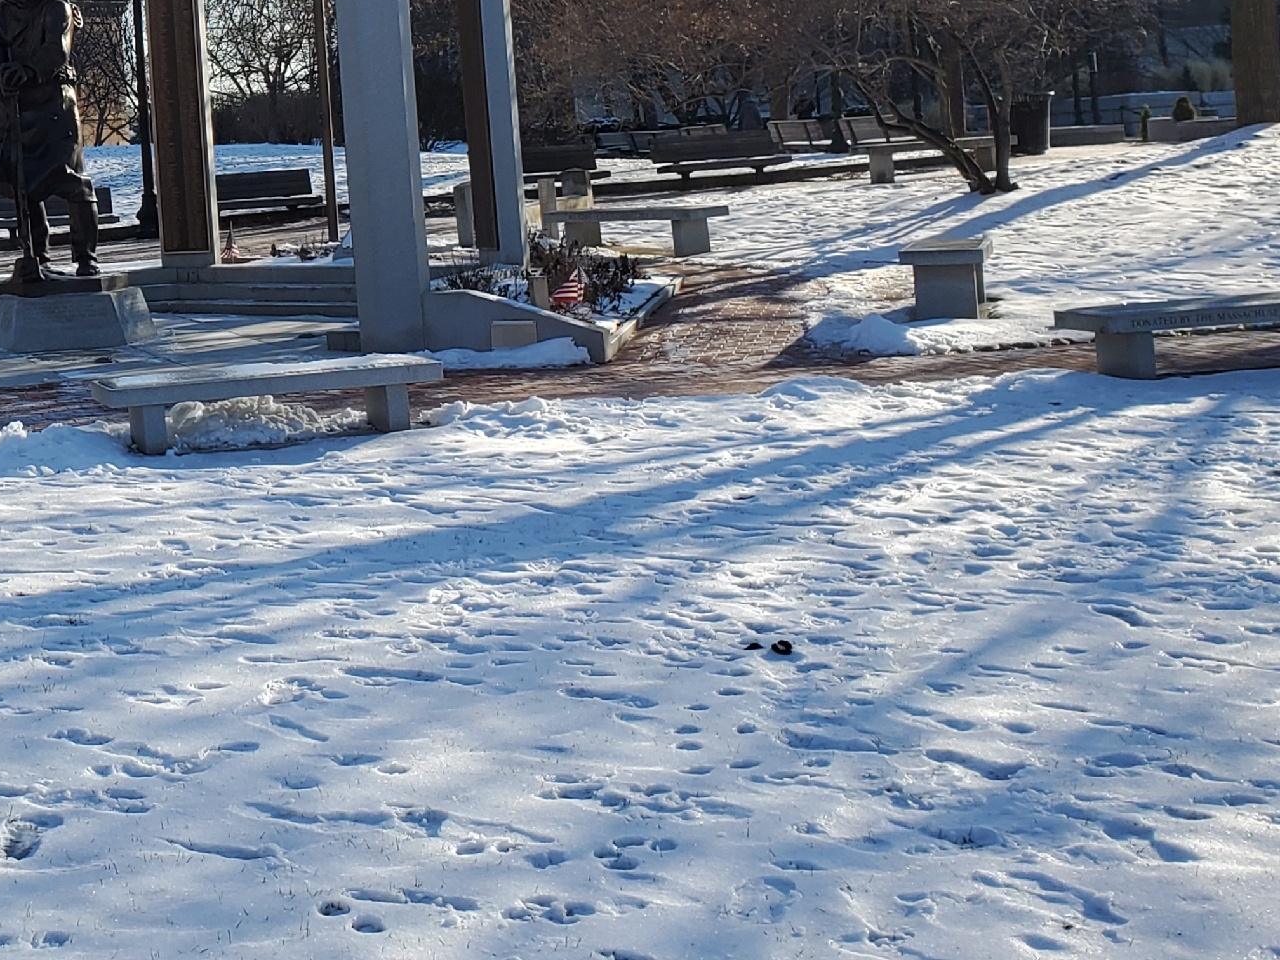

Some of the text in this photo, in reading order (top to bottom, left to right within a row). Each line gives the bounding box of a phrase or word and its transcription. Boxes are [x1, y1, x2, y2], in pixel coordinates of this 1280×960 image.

[1131, 308, 1278, 328] DONATED BY THE MASSACHUSE
